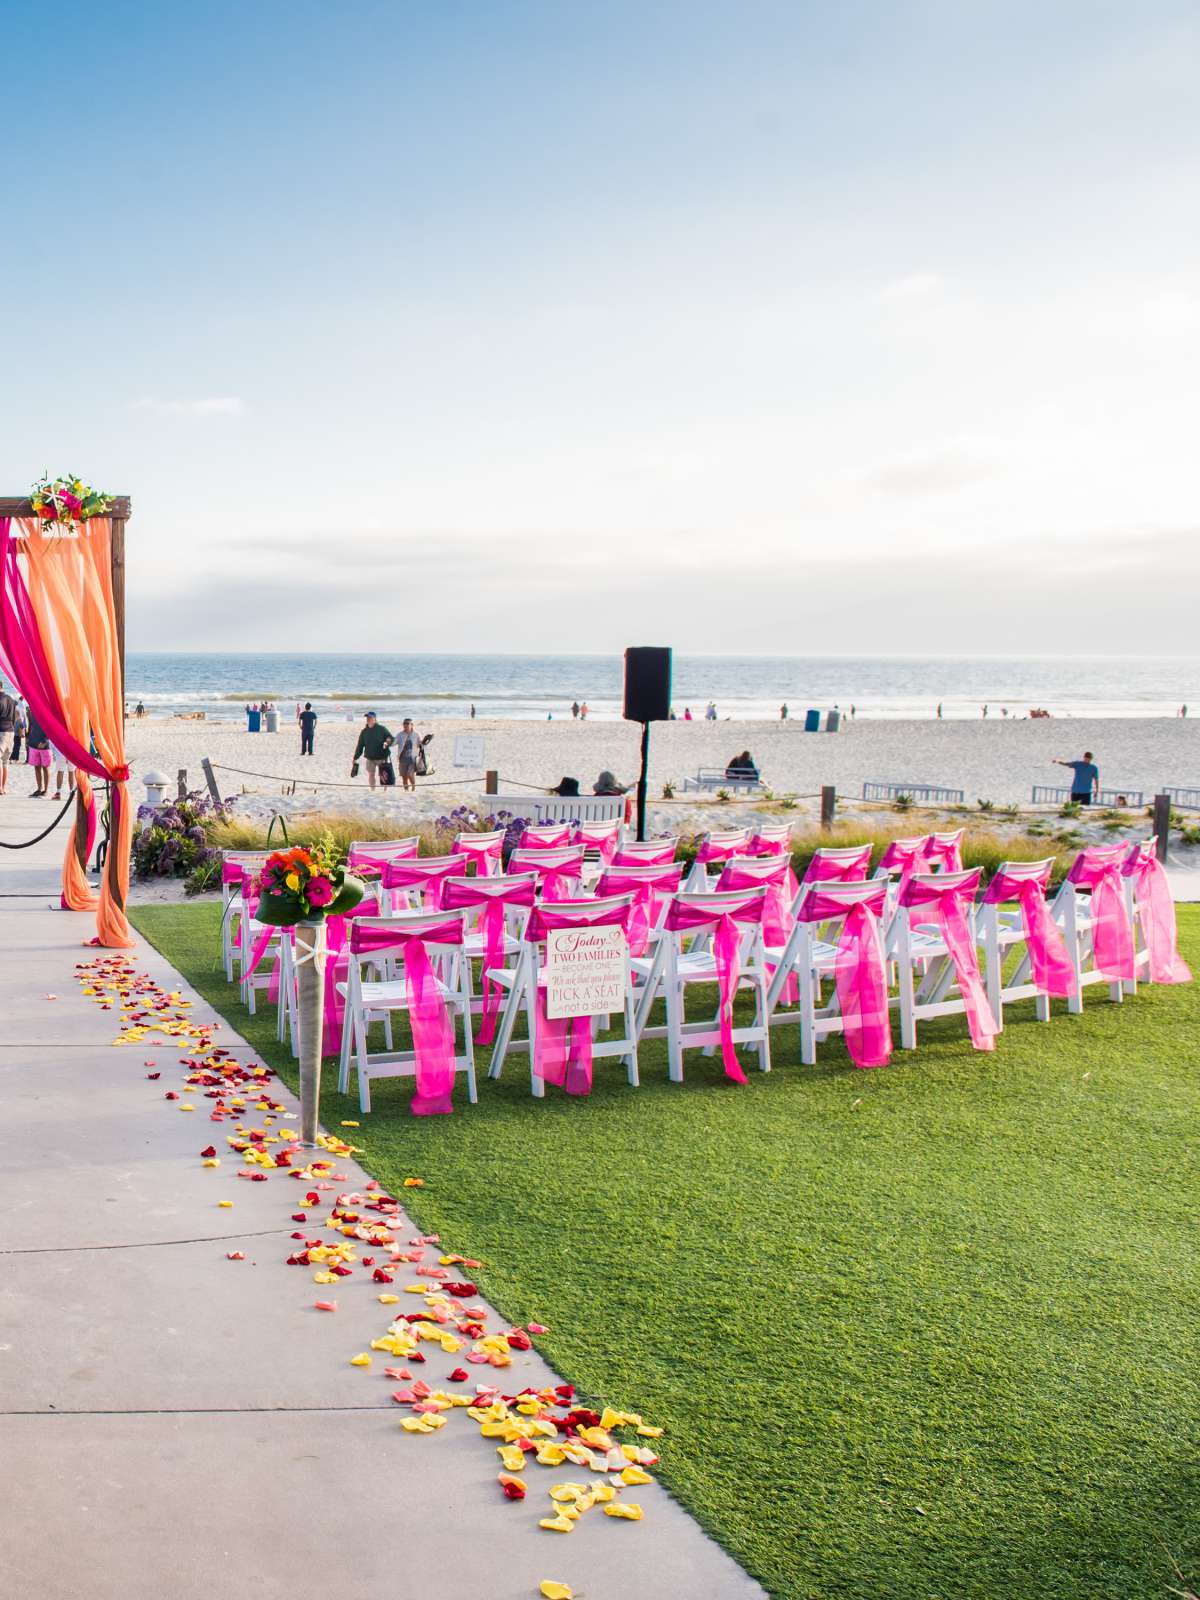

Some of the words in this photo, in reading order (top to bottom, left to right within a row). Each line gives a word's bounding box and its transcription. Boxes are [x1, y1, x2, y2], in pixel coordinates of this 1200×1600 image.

[552, 953, 575, 963] TWO
[578, 949, 621, 961] FAMILIES
[562, 963, 594, 973] BECOME
[595, 961, 610, 970] ONE
[552, 987, 580, 1001] PICK
[584, 987, 591, 999] A
[595, 984, 620, 998] SEAT
[564, 1002, 580, 1012] not
[582, 1002, 589, 1011] a
[591, 1000, 609, 1010] side
